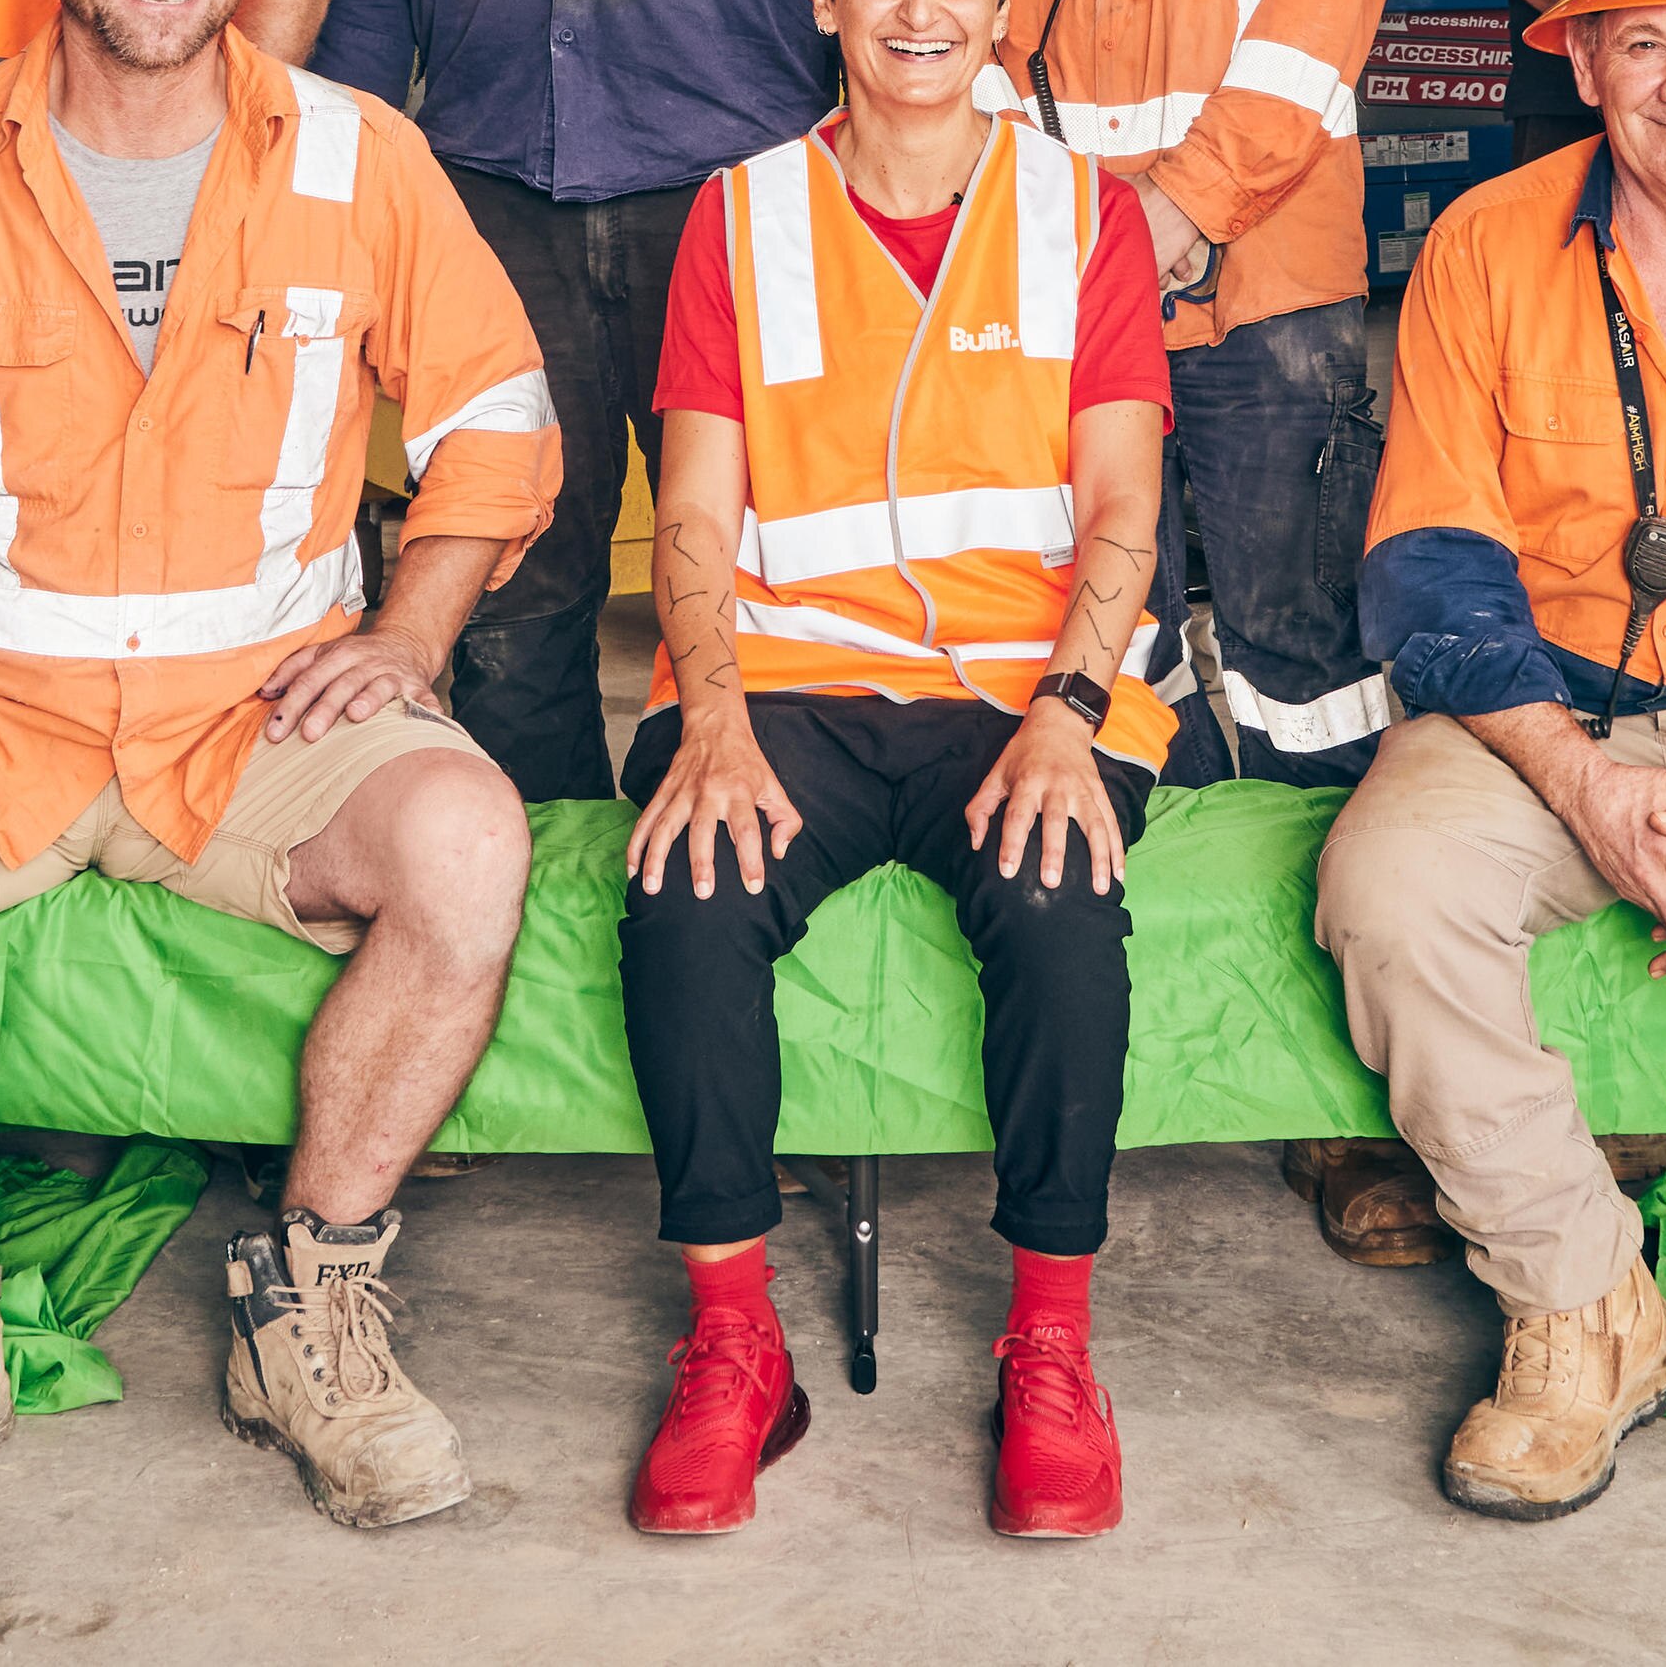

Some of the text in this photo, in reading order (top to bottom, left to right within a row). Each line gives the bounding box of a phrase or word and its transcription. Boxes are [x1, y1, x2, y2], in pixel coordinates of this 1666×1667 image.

[1389, 46, 1475, 65] ACCESS
[1372, 80, 1404, 97] PH
[1420, 80, 1446, 100] 13
[1450, 83, 1484, 102] 40
[949, 322, 1020, 353] Built.
[1614, 311, 1635, 369] BASAIR
[1626, 404, 1646, 472] #AIMHIGH
